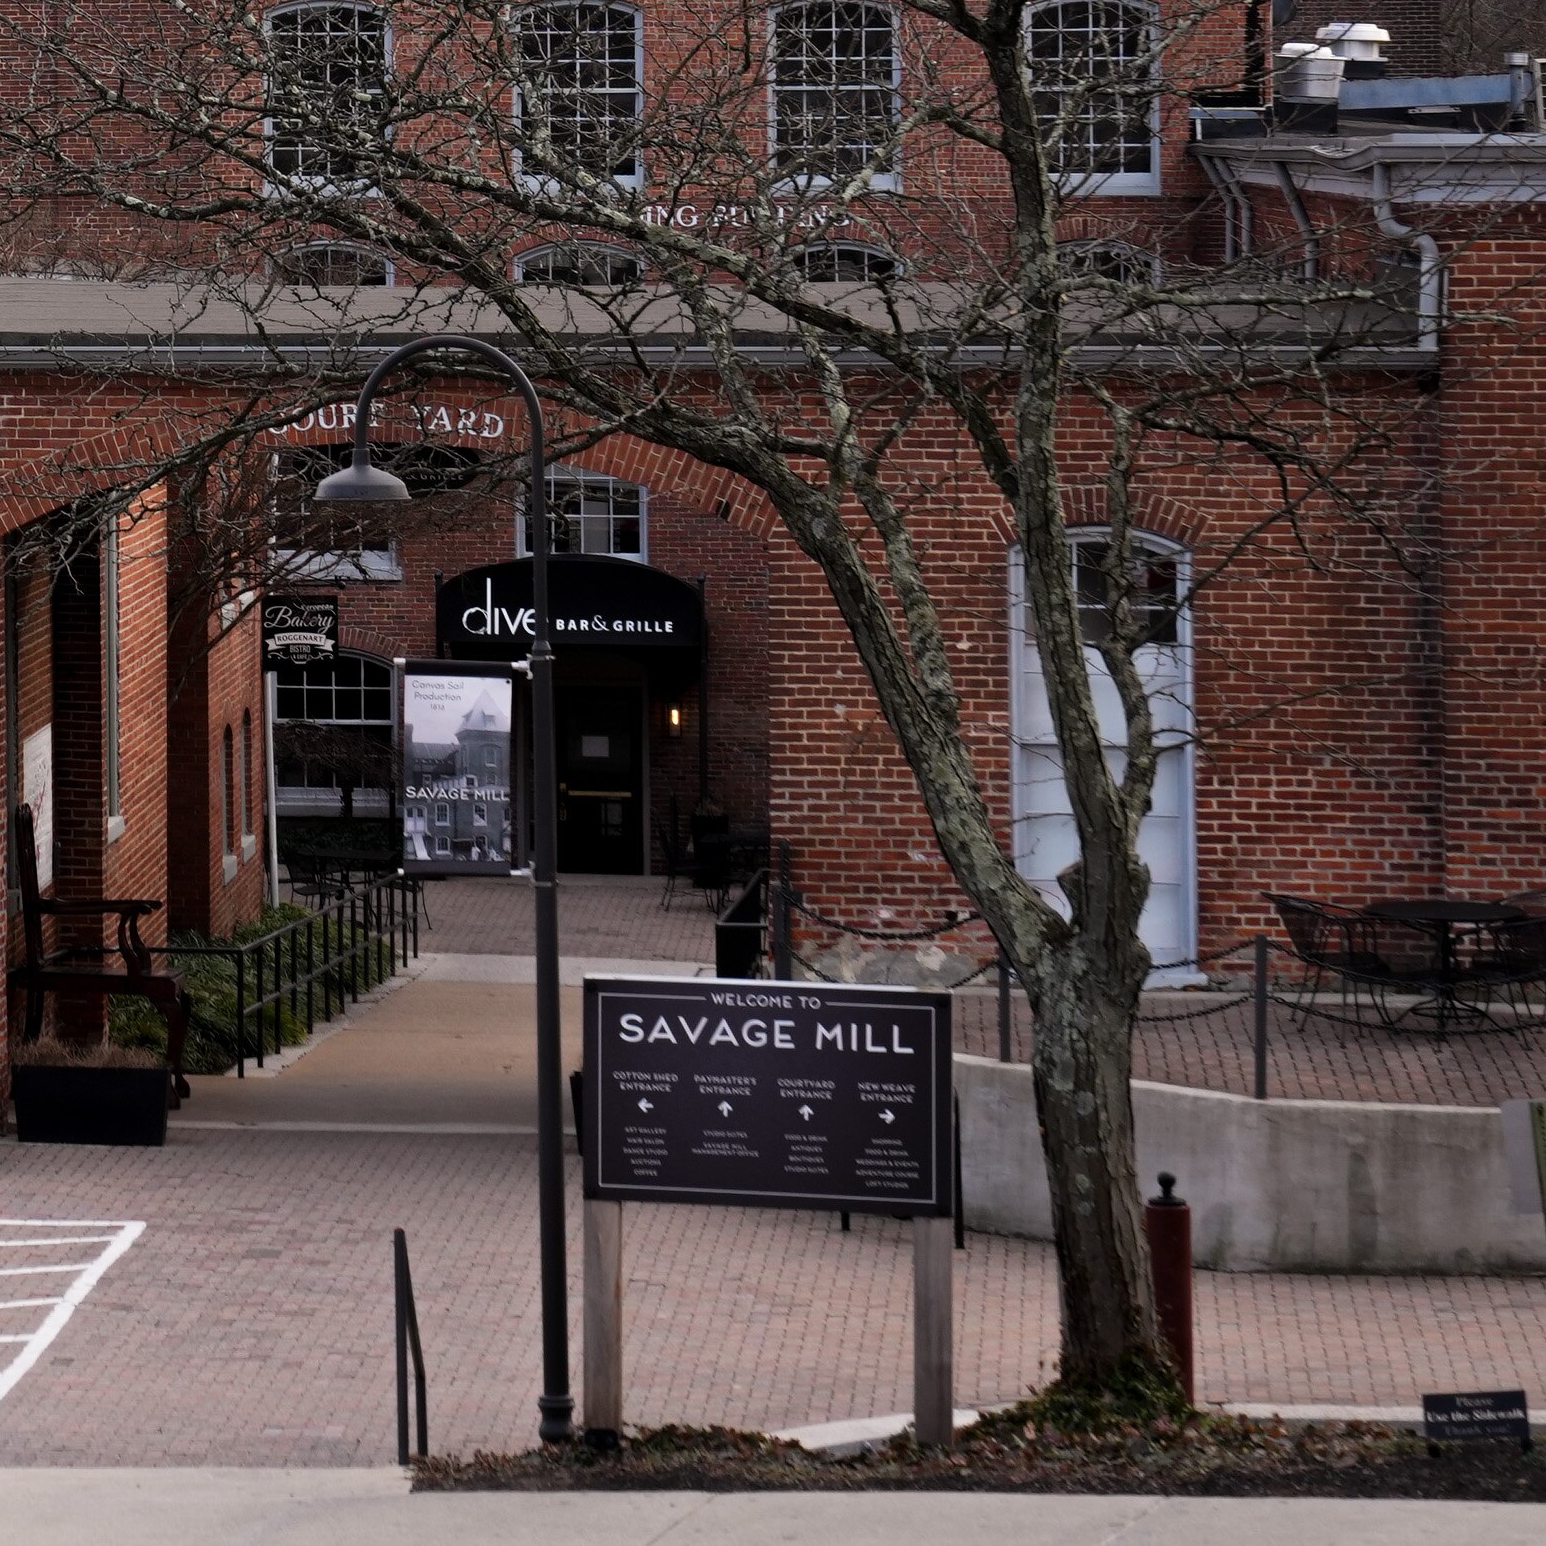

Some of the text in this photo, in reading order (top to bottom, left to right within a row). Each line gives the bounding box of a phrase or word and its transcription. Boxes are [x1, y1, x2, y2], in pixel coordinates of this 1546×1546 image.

[410, 405, 504, 438] YARD
[462, 577, 549, 636] dive
[263, 605, 335, 634] Bakery
[277, 634, 324, 643] ROGGENART
[289, 645, 311, 653] BISTRO
[412, 680, 446, 690] Canvas
[414, 691, 462, 701] Production
[405, 786, 510, 802] SAVAGE MILL
[710, 992, 822, 1010] WELCOME TO
[619, 1013, 915, 1054] SAVAGE MILL
[612, 1070, 679, 1083] COTTON SHED
[619, 1081, 672, 1093] ENTRANCE
[698, 1084, 752, 1096] ENTRANCE
[777, 1077, 836, 1090] COURTYARD
[857, 1081, 916, 1094] NEW WEAVE
[779, 1088, 832, 1100] ENTRANCE
[860, 1092, 914, 1104] ENTRANCE
[1455, 1397, 1494, 1407] Please
[1426, 1409, 1526, 1423] Use the Sidewalk
